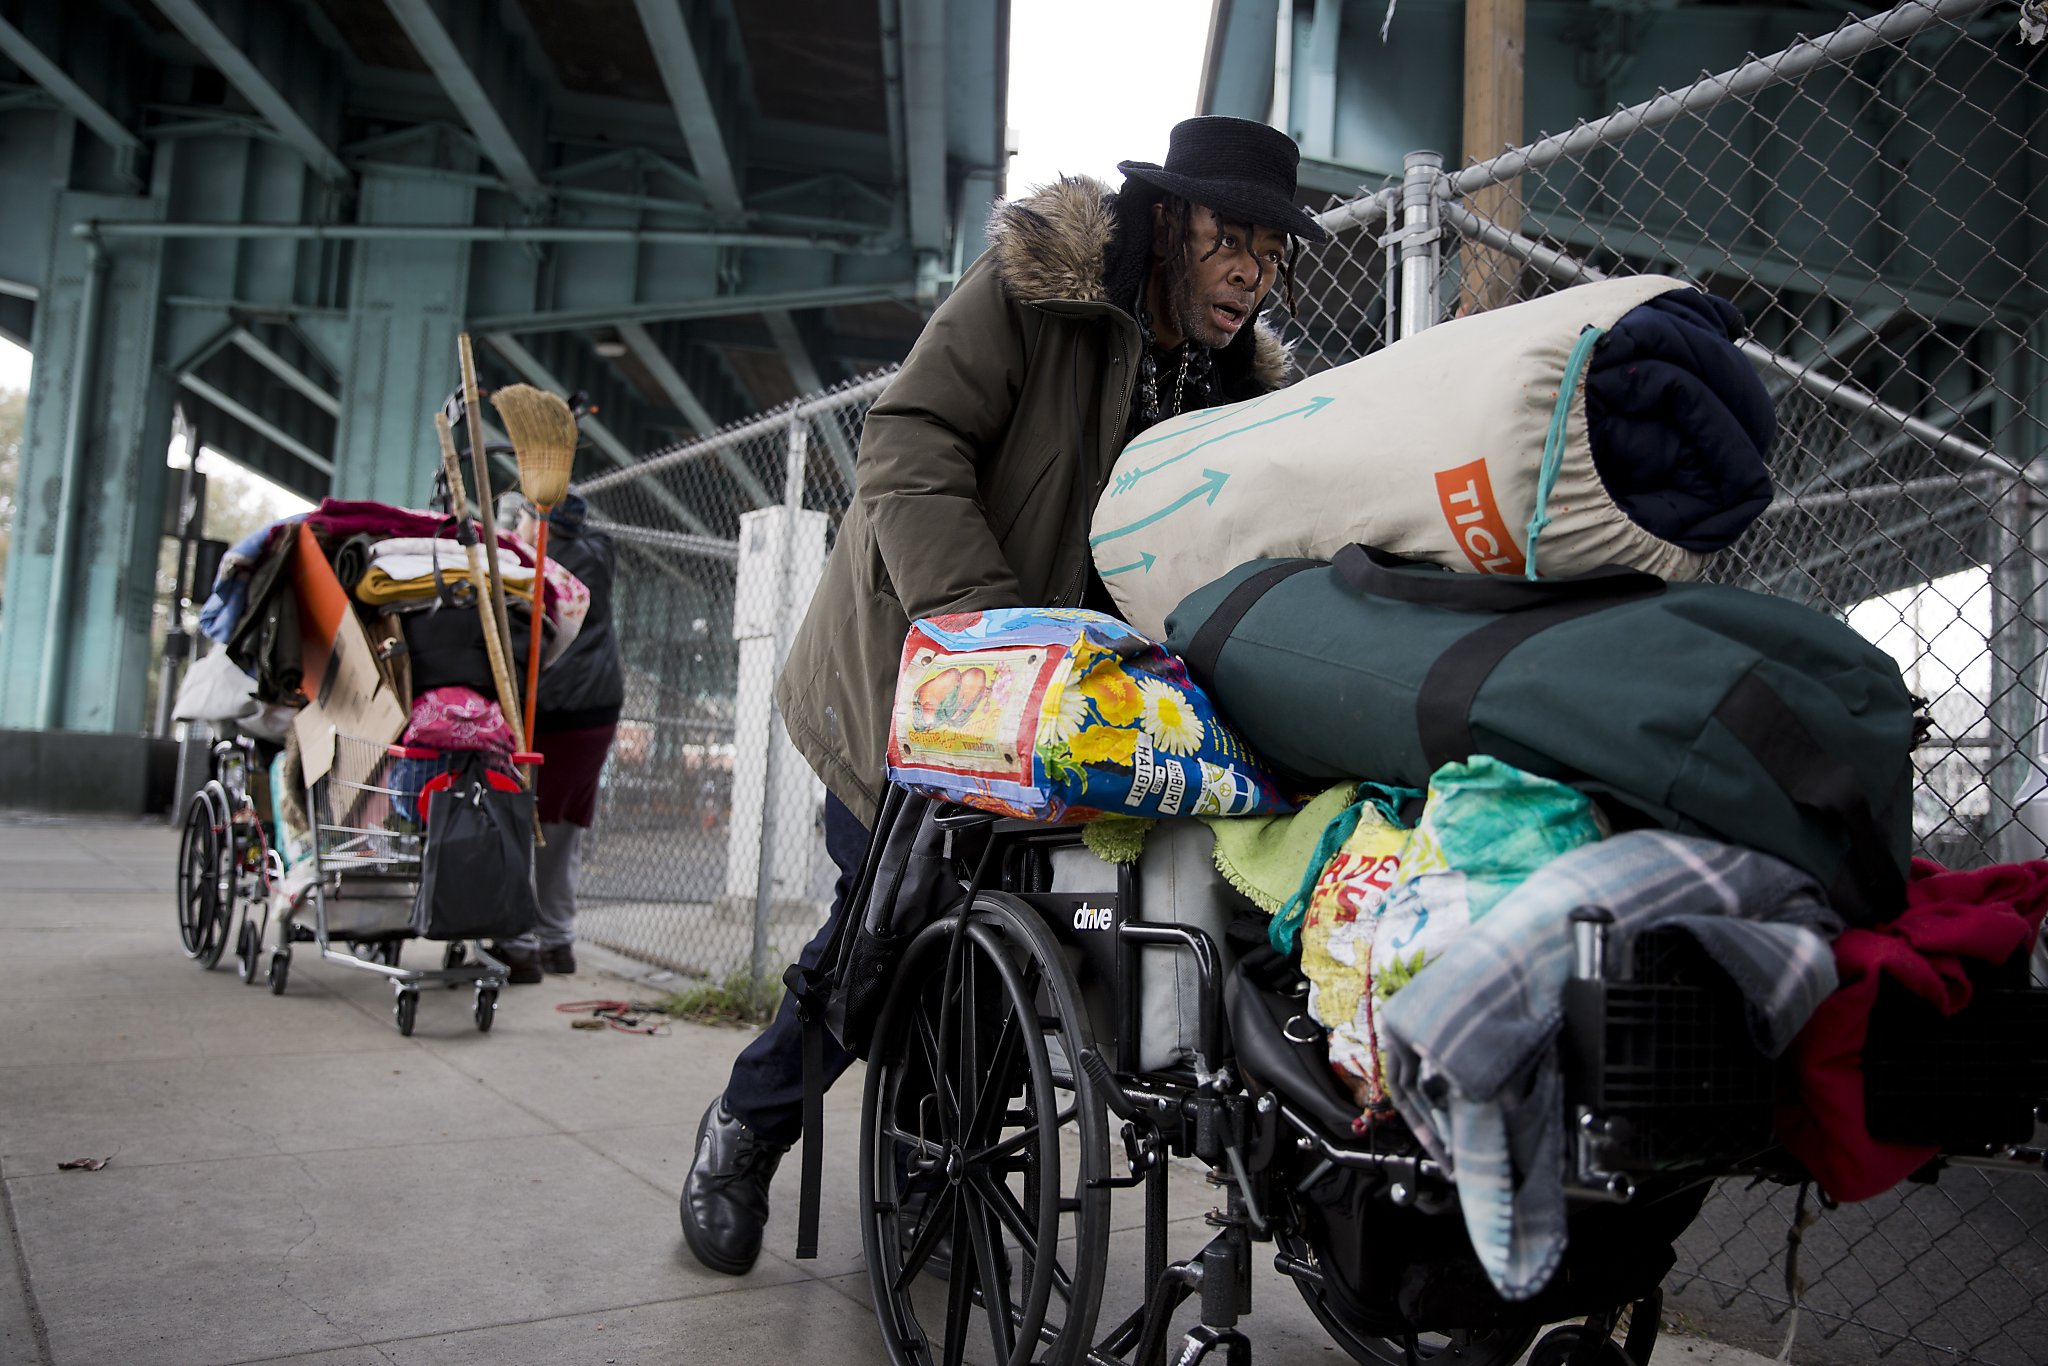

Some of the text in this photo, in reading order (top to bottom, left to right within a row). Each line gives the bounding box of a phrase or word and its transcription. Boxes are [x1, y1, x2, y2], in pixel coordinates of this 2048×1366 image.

[1131, 745, 1150, 801] HAIGHT
[1152, 777, 1163, 792] 1500
[1163, 762, 1183, 811] ASHBURY
[1316, 852, 1401, 891] ADE
[1073, 902, 1113, 930] drive
